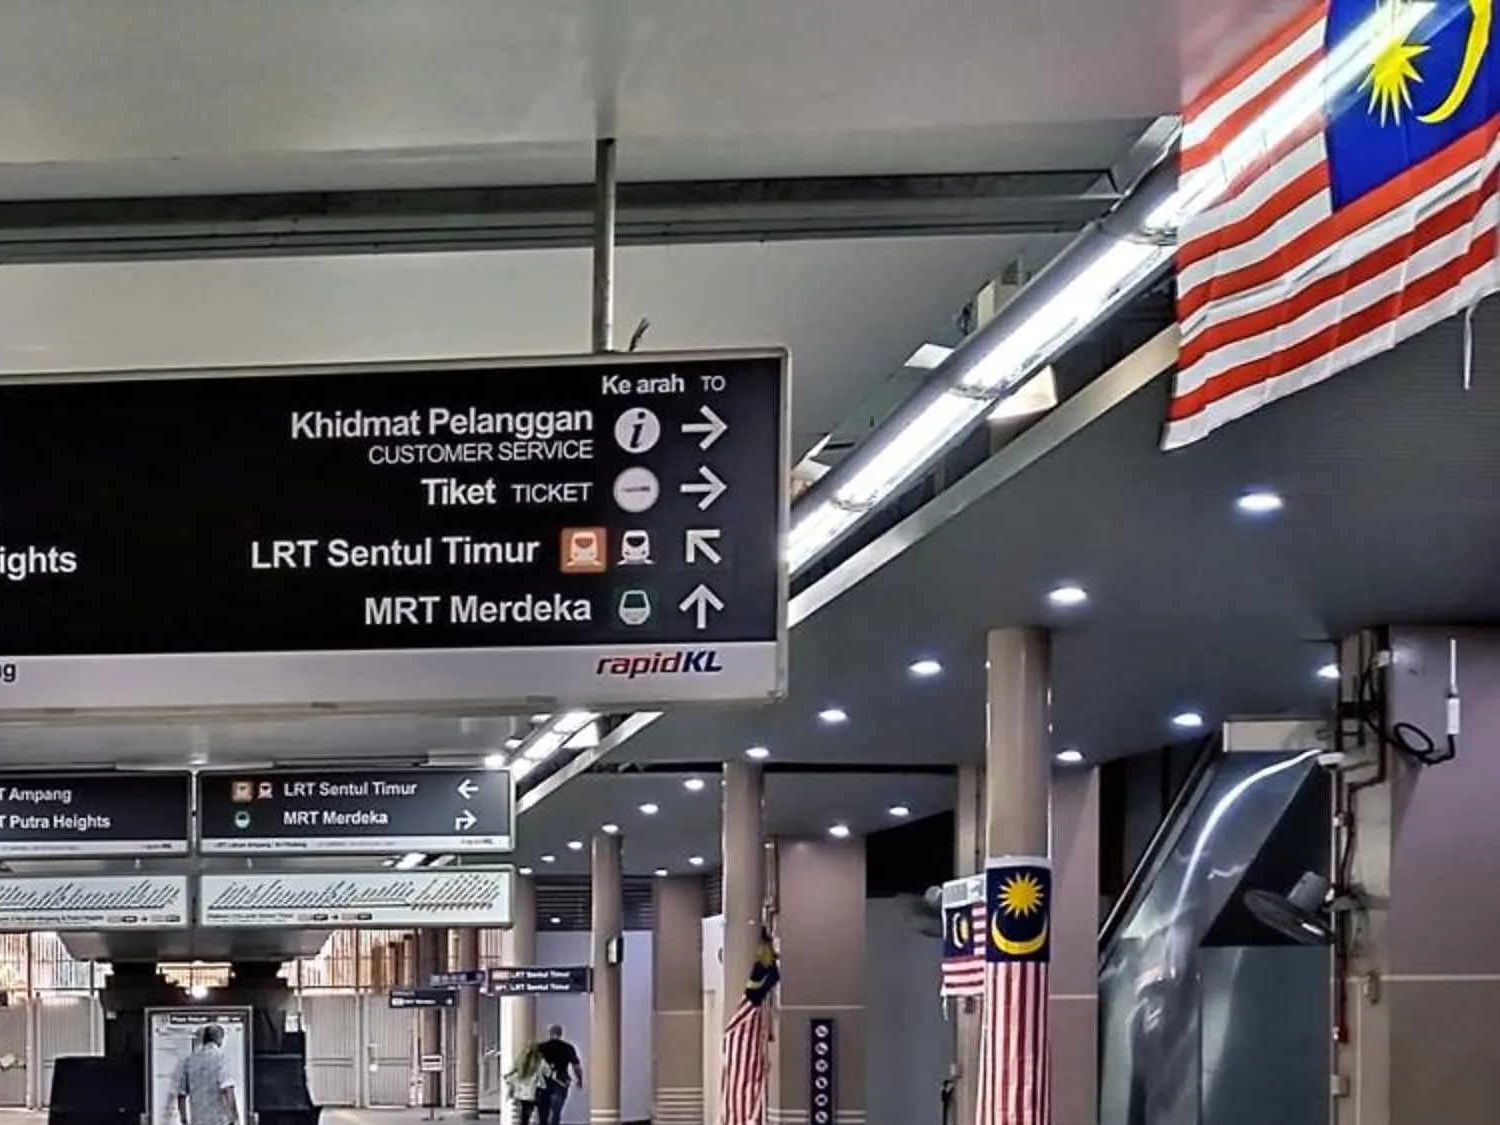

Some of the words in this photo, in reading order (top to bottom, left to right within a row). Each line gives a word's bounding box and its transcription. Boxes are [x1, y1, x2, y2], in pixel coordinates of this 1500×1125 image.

[601, 374, 632, 395] Ke
[635, 373, 685, 394] arah
[700, 375, 726, 392] TO
[291, 409, 421, 439] Khidmat
[429, 406, 593, 440] Pelanggan
[368, 442, 494, 465] CUSTOMER
[497, 439, 594, 461] SERVICE
[420, 477, 497, 506] Tiket
[511, 481, 593, 503] TICKET
[251, 539, 319, 569] LRT
[327, 537, 432, 568] Sentul
[441, 535, 541, 565] Timur
[365, 595, 441, 625] MRT
[450, 593, 592, 623] Merdeka
[596, 650, 723, 680] rapidKL
[8, 787, 72, 804] Ampang
[283, 782, 316, 797] LRT
[319, 781, 367, 797] Sentul
[370, 781, 418, 795] Timur
[9, 814, 50, 829] Putra
[53, 814, 111, 832] Heights
[283, 810, 320, 825] MRT
[322, 810, 389, 825] Merdeka
